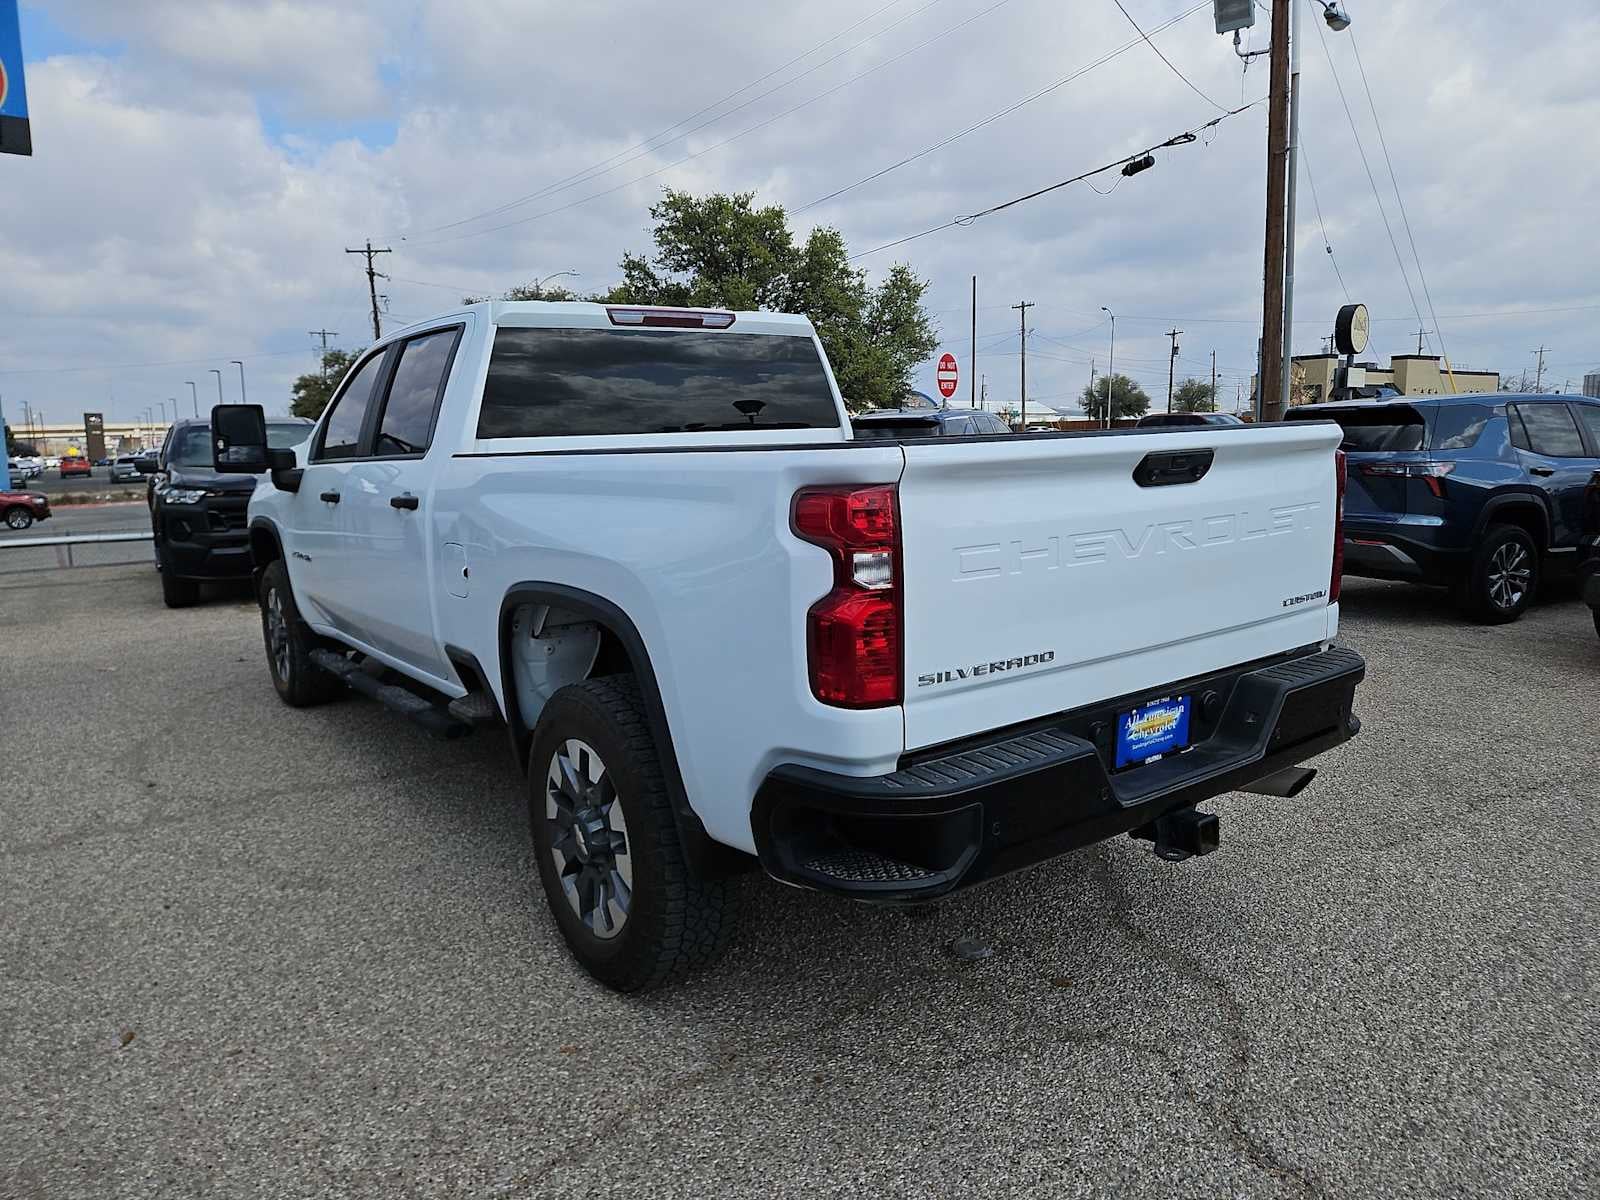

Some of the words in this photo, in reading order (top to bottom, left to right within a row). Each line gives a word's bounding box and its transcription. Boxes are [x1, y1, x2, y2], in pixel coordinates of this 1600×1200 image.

[941, 381, 954, 390] ENTER
[952, 501, 1321, 583] CHEVROLET
[918, 650, 1055, 687] SILVERADO
[1124, 714, 1139, 729] All
[1143, 704, 1184, 722] American
[1131, 719, 1176, 740] Chevrolet
